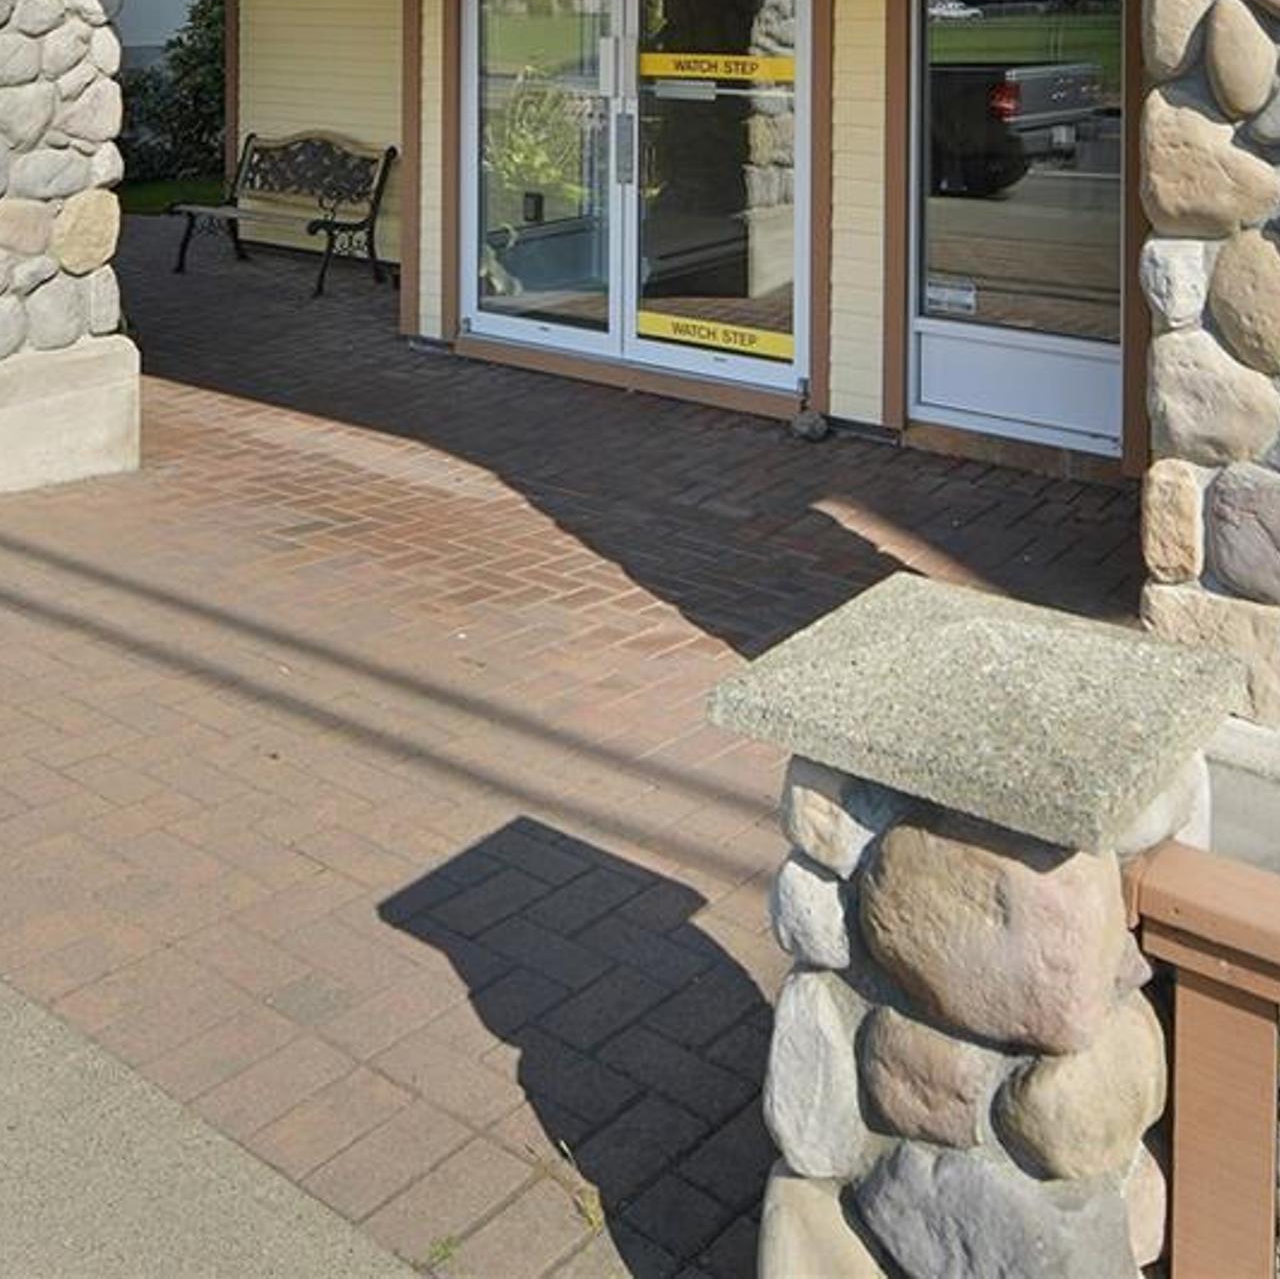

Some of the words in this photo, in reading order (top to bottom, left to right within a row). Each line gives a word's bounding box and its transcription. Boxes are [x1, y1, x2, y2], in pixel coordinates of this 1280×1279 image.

[673, 60, 718, 74] WATCH
[724, 61, 760, 76] STEP
[671, 321, 717, 340] WATCH
[721, 328, 758, 347] STEP
